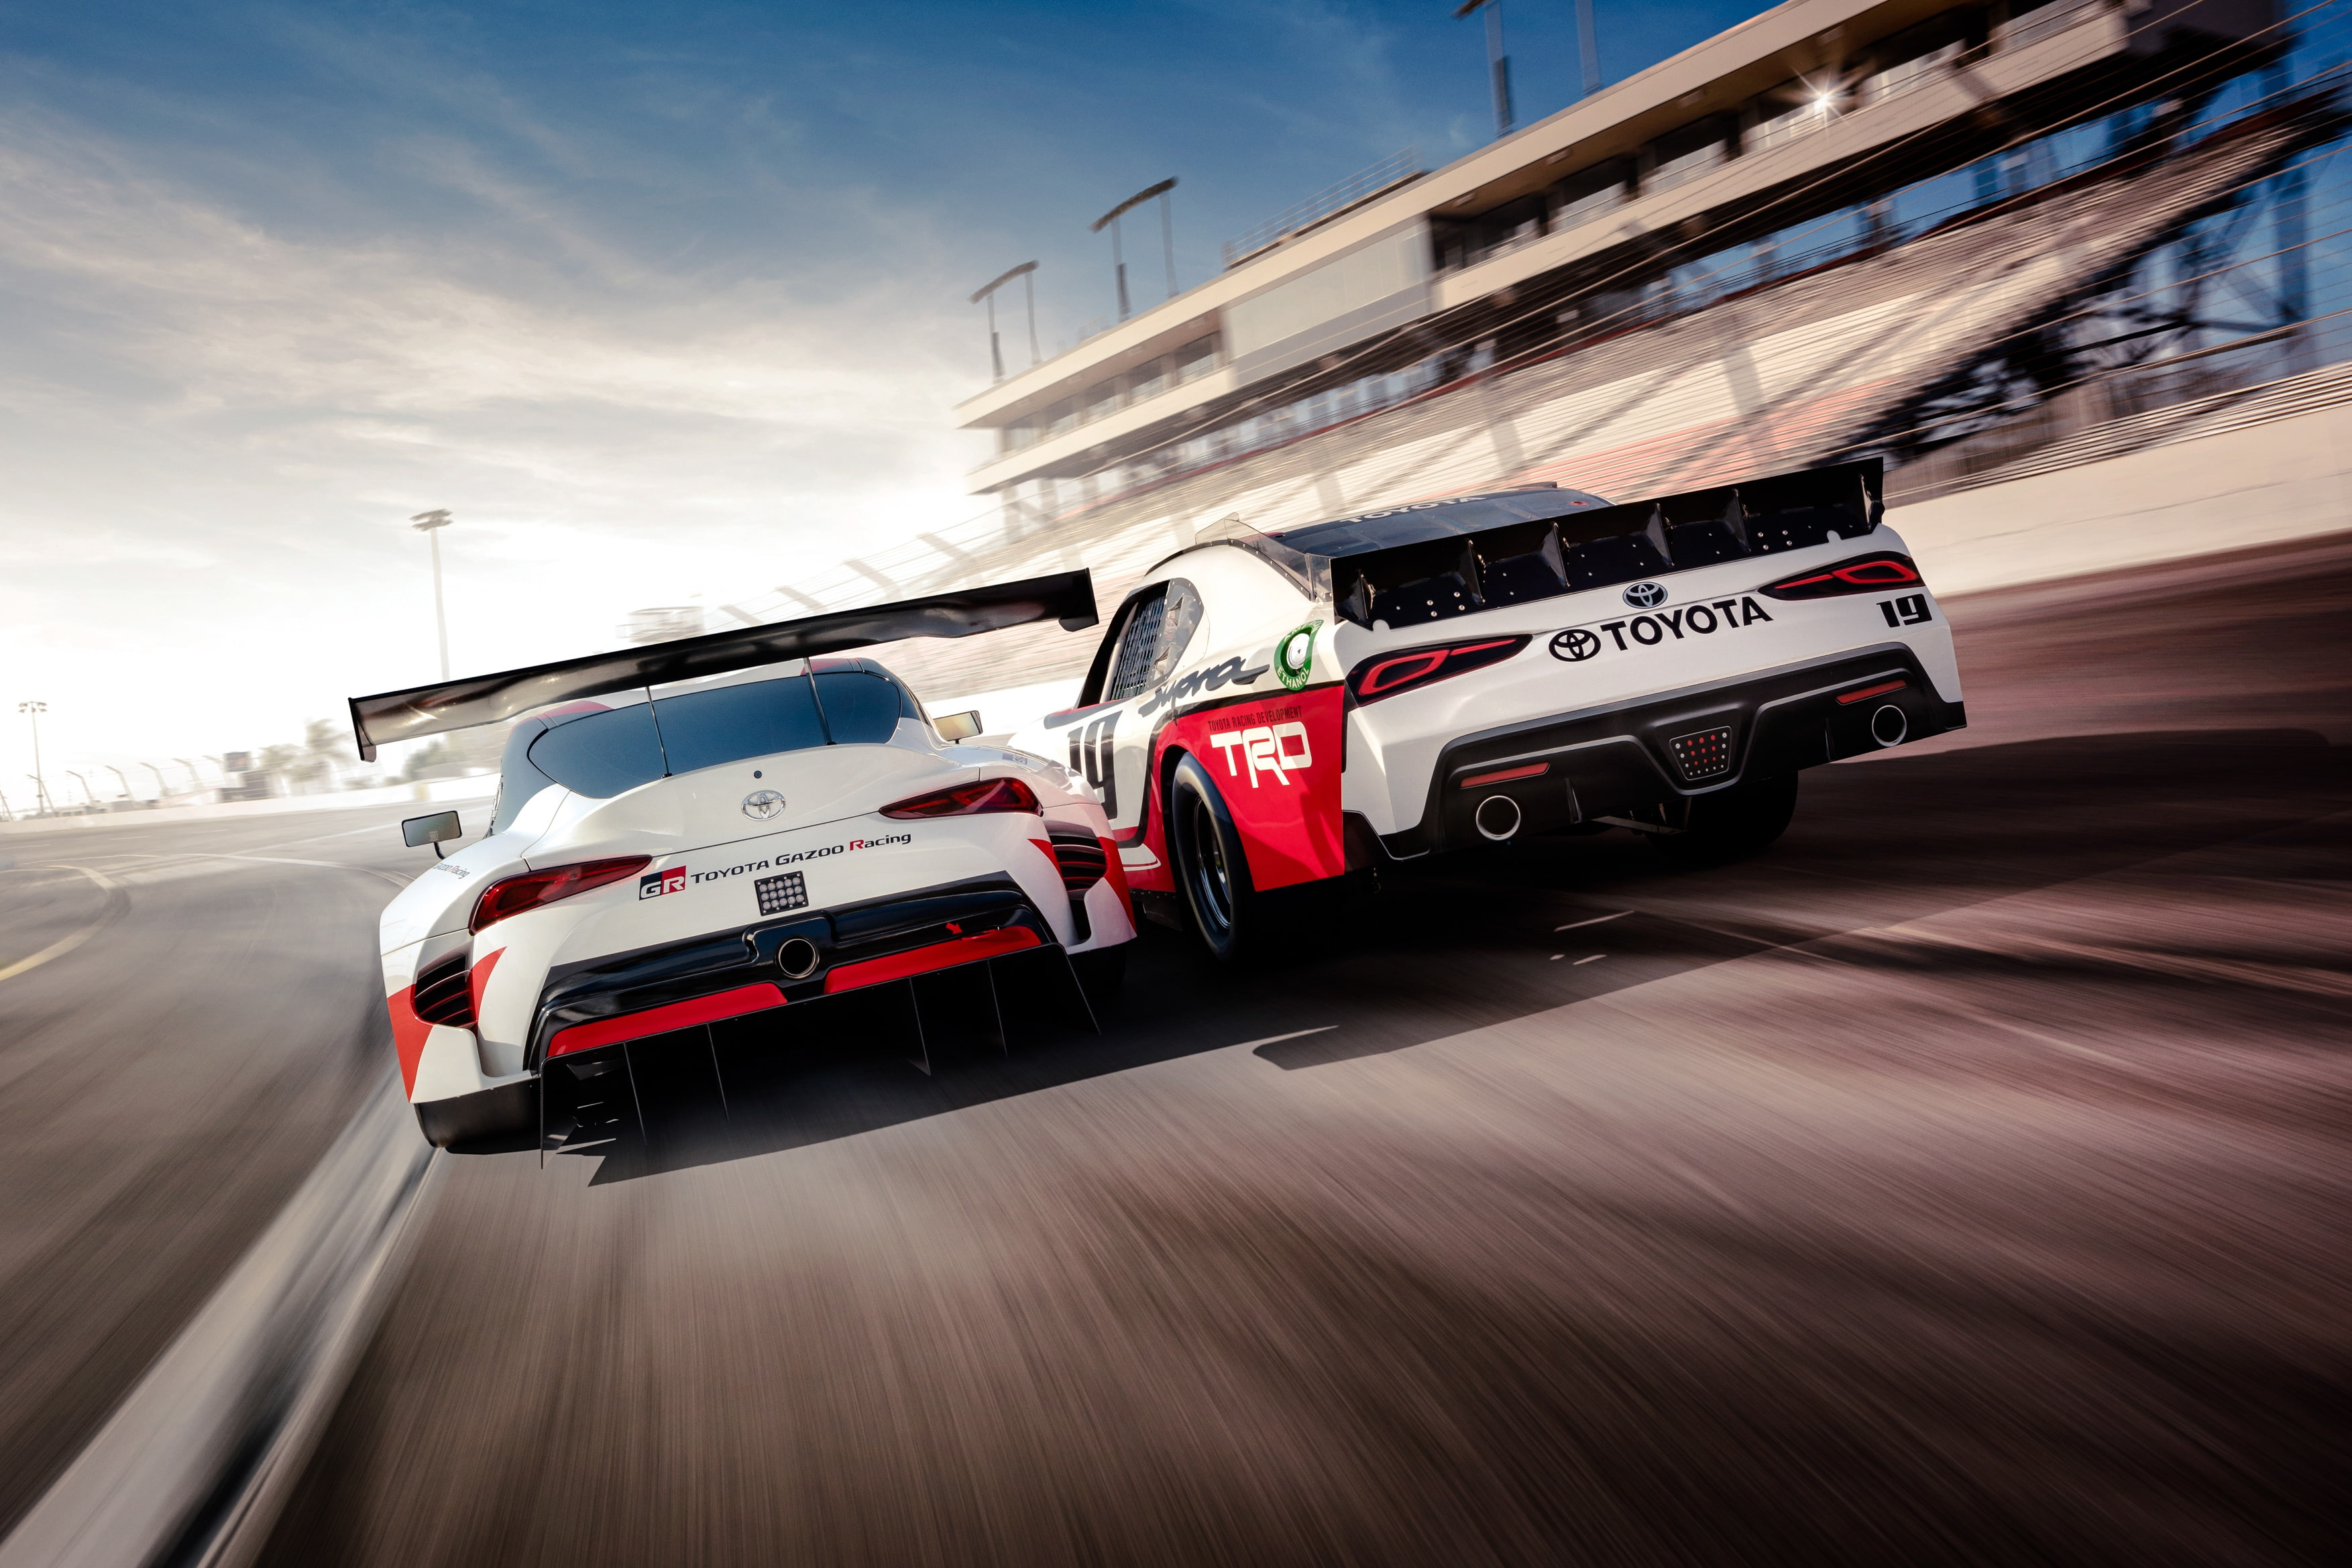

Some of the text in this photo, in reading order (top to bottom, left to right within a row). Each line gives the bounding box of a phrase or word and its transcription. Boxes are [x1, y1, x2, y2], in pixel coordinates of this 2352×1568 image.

[1339, 497, 1487, 522] TOYOTA
[1600, 596, 1774, 651] TOYOTA
[1876, 594, 1933, 628] 19
[1277, 666, 1309, 688] ETHANOL
[1208, 706, 1302, 732] TOYOTA RACING DEVELOPMENT
[1210, 721, 1312, 789] TRD
[640, 834, 911, 899] GR TOYOTA GAZOO Racing
